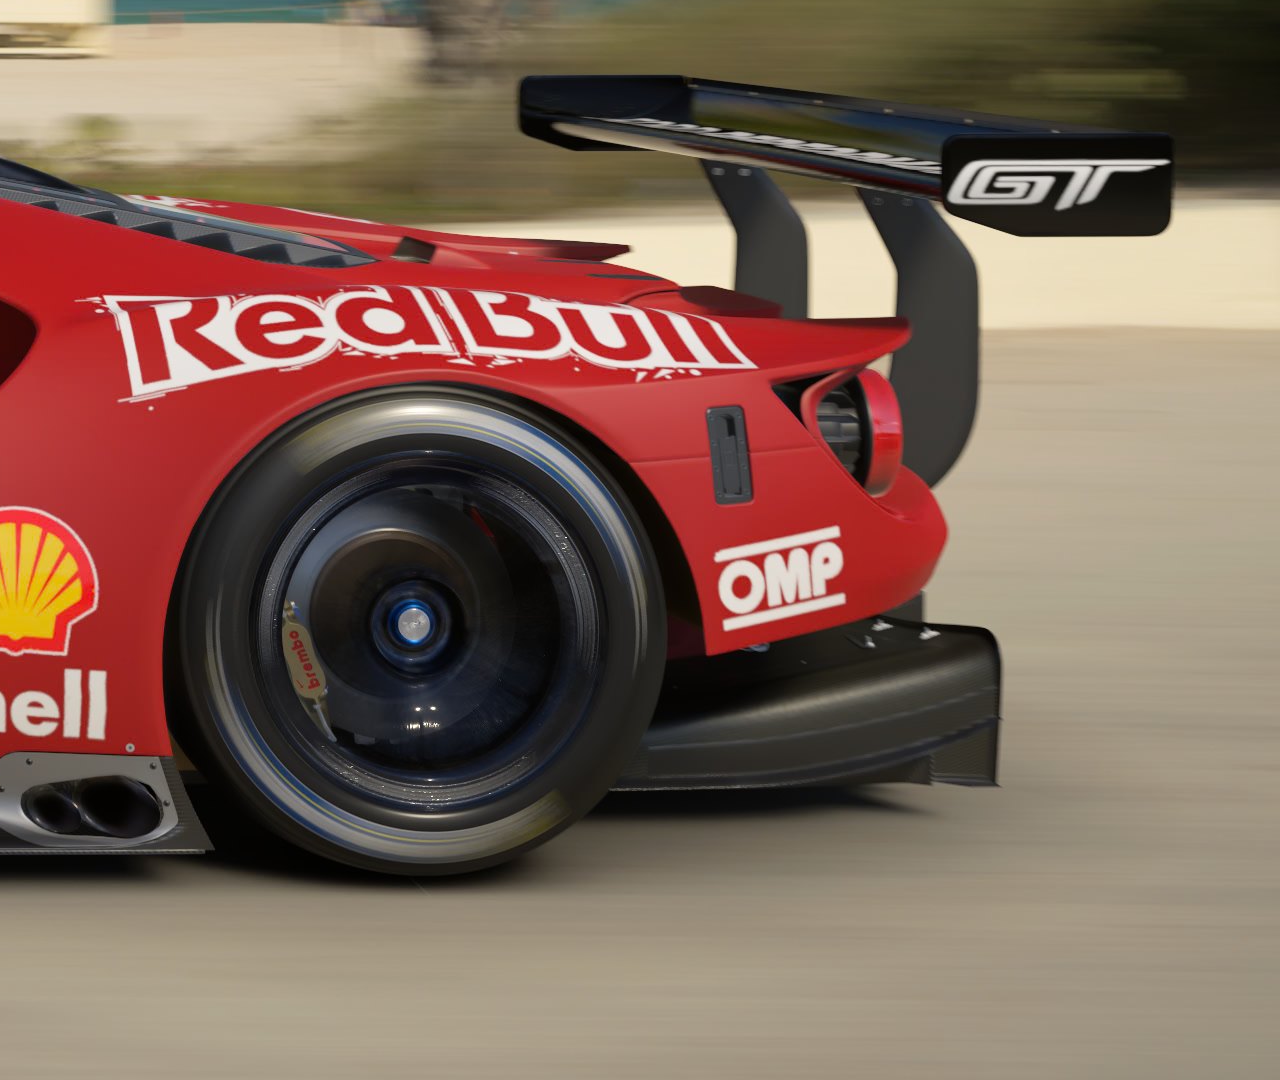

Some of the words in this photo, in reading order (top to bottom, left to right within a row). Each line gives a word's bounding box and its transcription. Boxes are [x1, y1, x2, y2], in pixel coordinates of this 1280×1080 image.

[947, 159, 1170, 210] GT
[100, 284, 450, 397] Red
[445, 289, 760, 382] Bull
[718, 541, 844, 615] OMP
[289, 630, 321, 690] brembo
